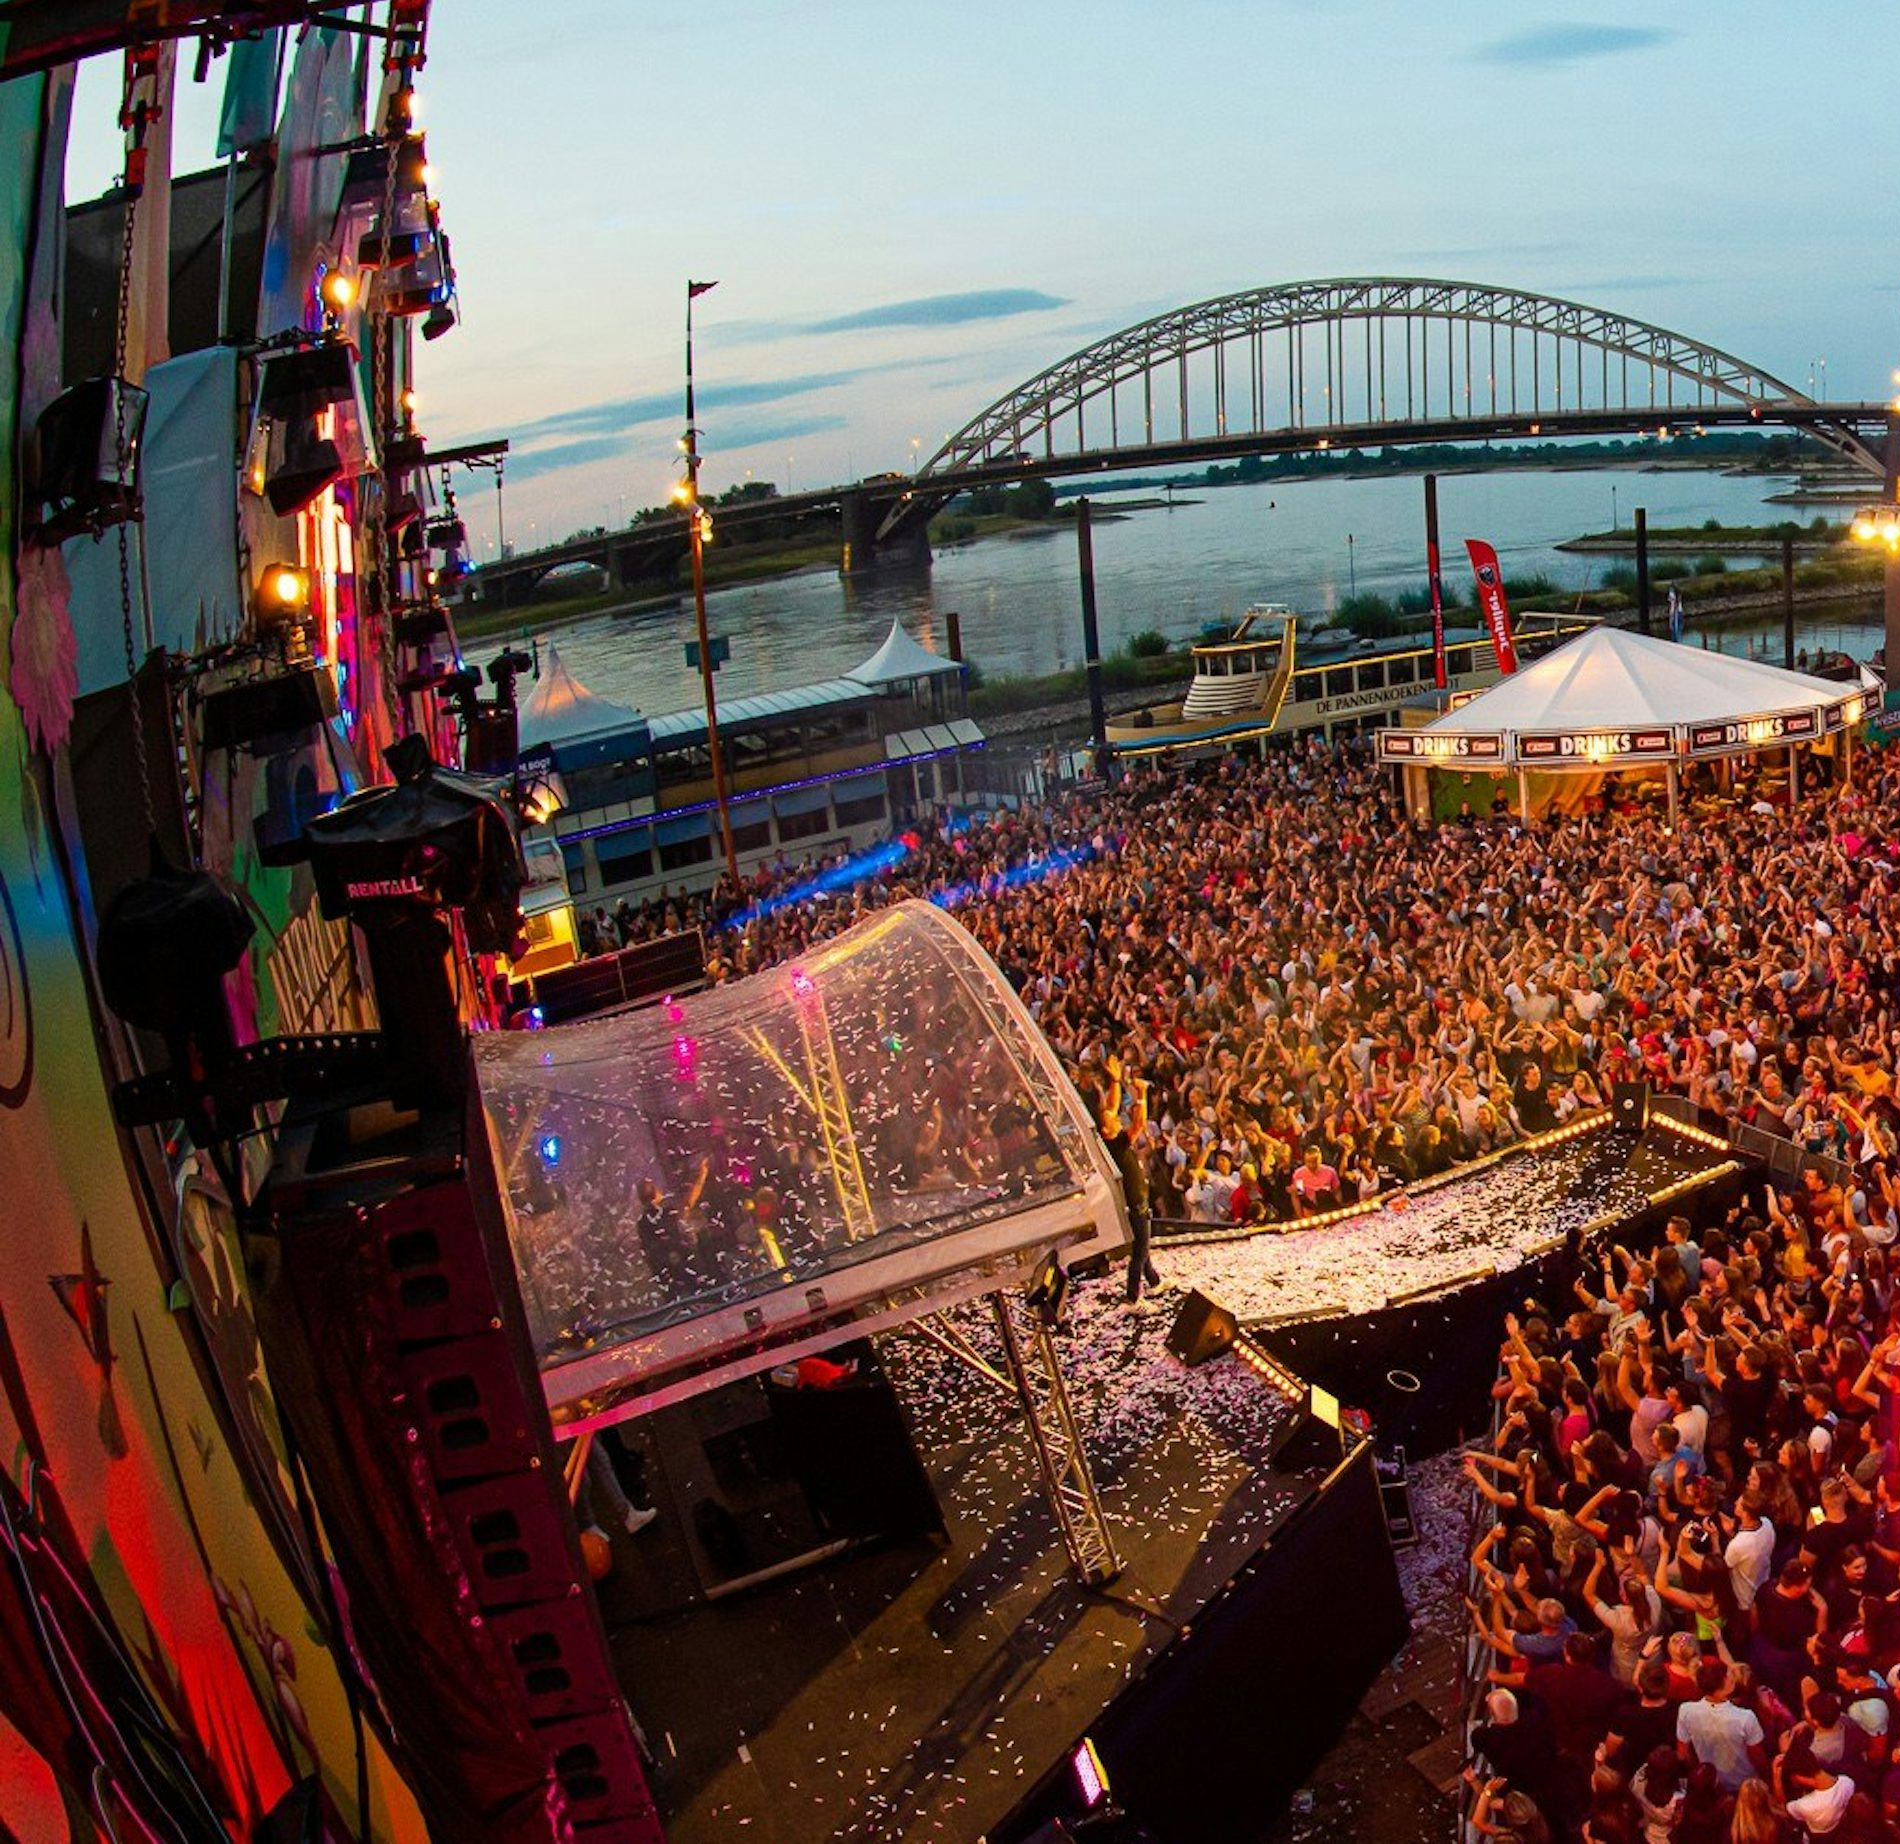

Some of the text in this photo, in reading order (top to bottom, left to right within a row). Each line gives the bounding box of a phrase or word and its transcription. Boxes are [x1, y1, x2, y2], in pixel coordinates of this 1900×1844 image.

[1316, 702, 1331, 714] DE
[1726, 717, 1785, 744] DRINKS
[1413, 736, 1469, 756] DRINKS
[1560, 733, 1632, 756] DRINKS
[347, 876, 424, 899] RENTALL
